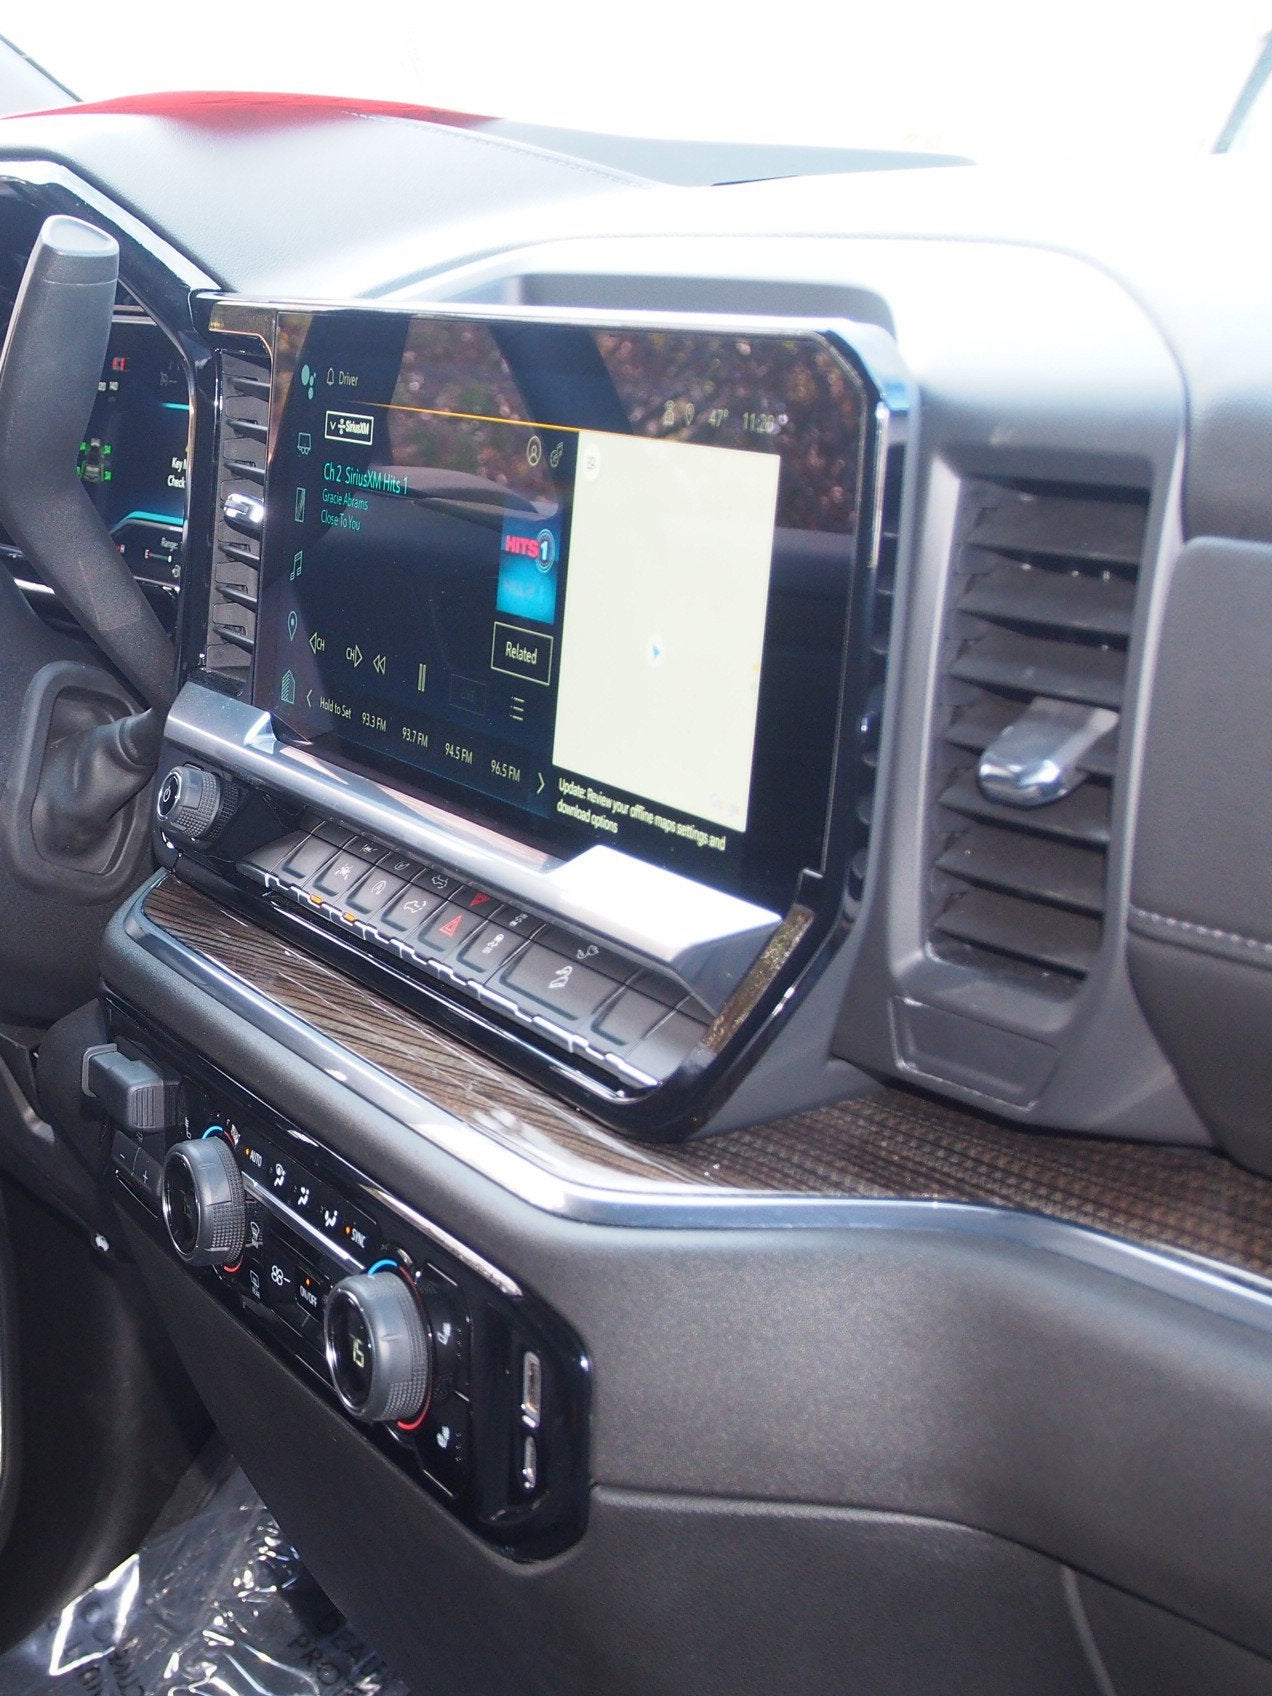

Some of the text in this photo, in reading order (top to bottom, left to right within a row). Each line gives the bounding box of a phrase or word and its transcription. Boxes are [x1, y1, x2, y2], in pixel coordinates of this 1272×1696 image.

[338, 370, 358, 387] Driver
[345, 419, 369, 435] SiriusXM
[172, 457, 183, 472] Key
[168, 474, 185, 488] Check
[323, 461, 408, 495] Ch 2 SiriusXM Hits 1
[322, 488, 369, 511] Gracie Abrams
[320, 509, 361, 531] Close To You
[505, 534, 548, 561] HITS 1
[505, 641, 538, 665] Related
[319, 696, 352, 720] Hold to Set
[361, 712, 387, 732] 93.3 FM
[402, 727, 428, 748] 93.7 FM
[445, 742, 473, 765] 94.5 FM
[491, 759, 521, 782] 96.5 FM
[557, 798, 619, 834] download options
[559, 778, 727, 852] Update: Review your offline maps settings and
[249, 1149, 263, 1168] AUTO
[350, 1228, 367, 1249] SYNC
